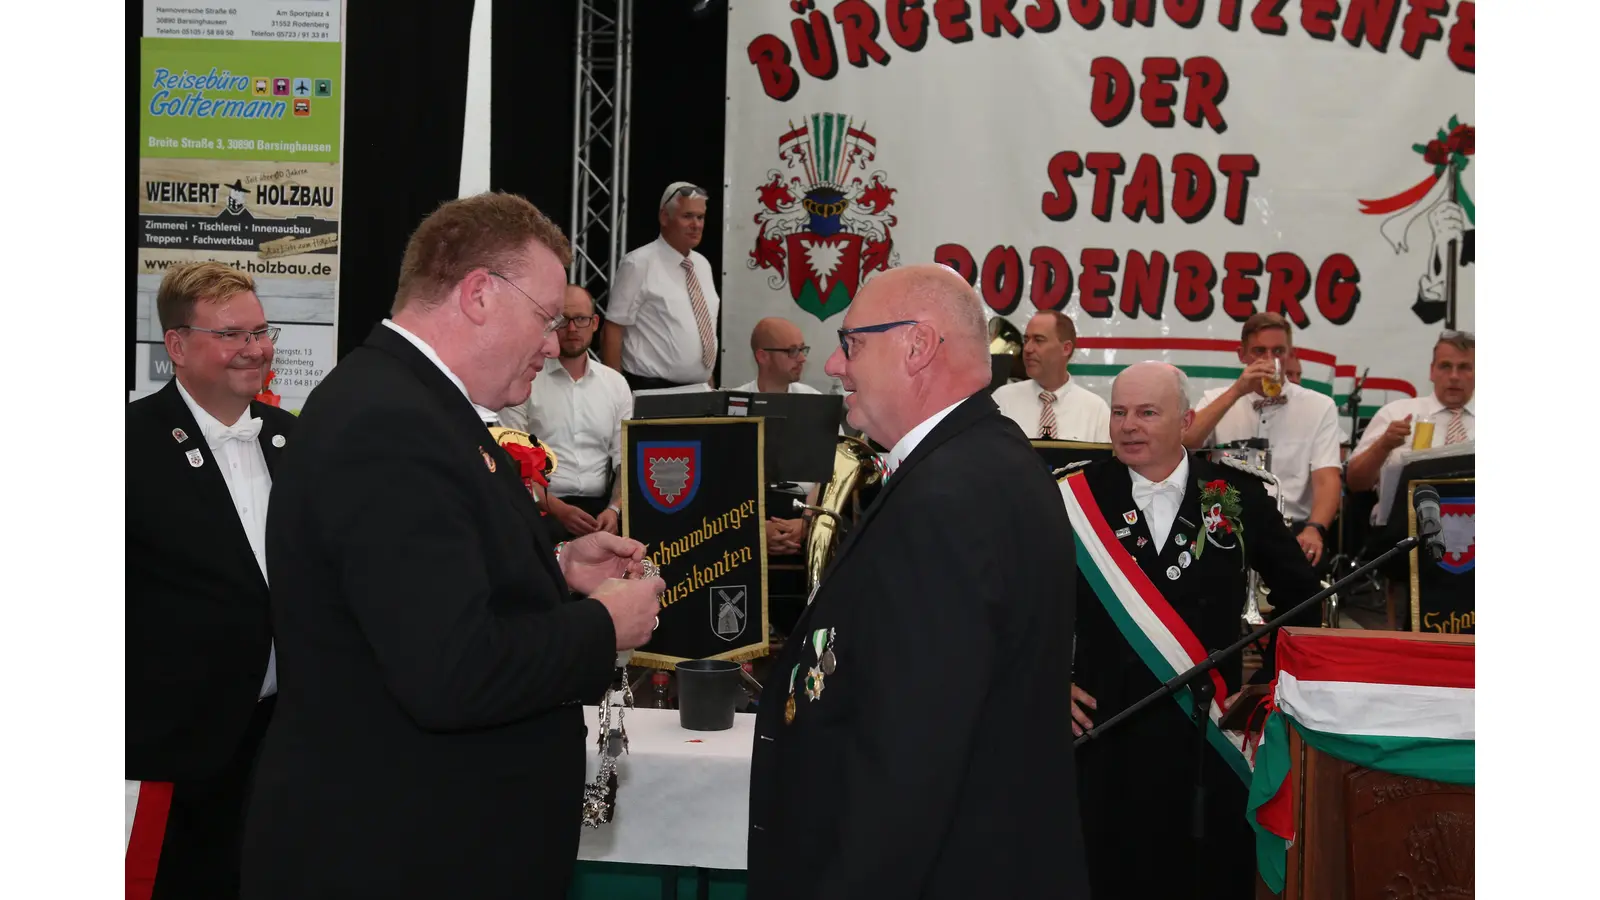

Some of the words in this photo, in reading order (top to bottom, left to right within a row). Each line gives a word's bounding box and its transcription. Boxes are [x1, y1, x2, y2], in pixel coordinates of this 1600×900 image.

[205, 7, 227, 15] Straße
[177, 18, 228, 26] Barsinghausen
[292, 21, 330, 29] Rodenberg
[152, 66, 250, 91] Reisebüro
[1089, 56, 1229, 133] DER
[149, 90, 287, 120] Goltermann
[148, 136, 179, 148] Breite
[181, 137, 214, 149] Straße
[216, 139, 225, 150] 3,
[227, 139, 255, 150] 30890
[257, 140, 332, 153] Barsinghausen
[285, 168, 309, 178] Jahren
[1040, 150, 1260, 225] STADT
[146, 181, 220, 203] WEIKERT
[256, 184, 335, 208] HOLZBAU
[145, 220, 188, 231] Zimmerei
[198, 222, 241, 232] Tischlerei
[252, 223, 311, 234] Innenausbau
[145, 234, 182, 244] Treppen
[193, 235, 254, 246] Fachwerkbau
[273, 348, 302, 356] bergstr.
[304, 348, 313, 356] 13
[275, 357, 314, 367] Rodenberg
[294, 368, 302, 376] 91
[284, 378, 292, 386] 81
[304, 379, 313, 387] 81
[645, 499, 756, 568] chaumburger
[659, 546, 753, 609] usikanten
